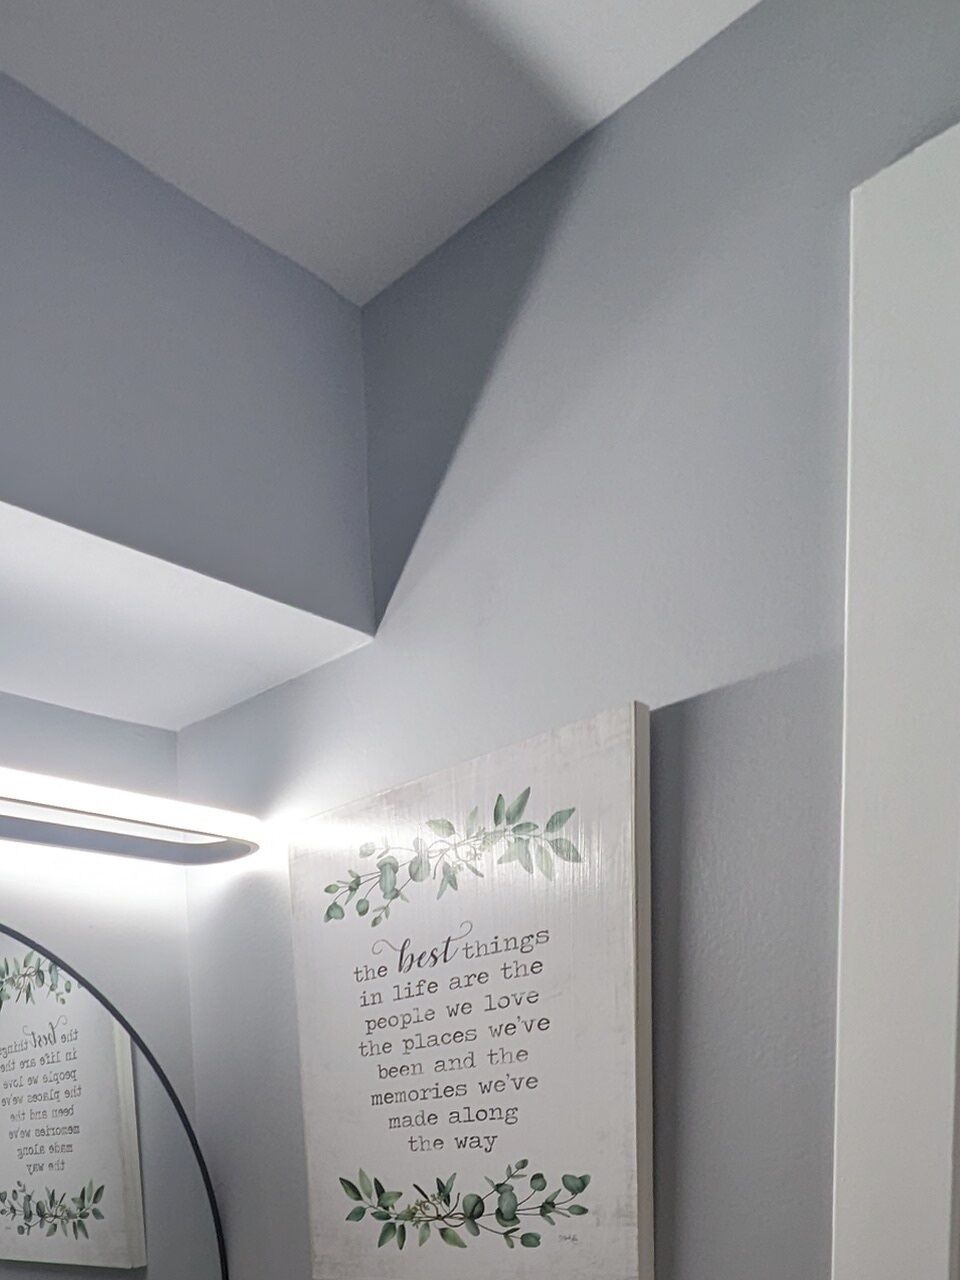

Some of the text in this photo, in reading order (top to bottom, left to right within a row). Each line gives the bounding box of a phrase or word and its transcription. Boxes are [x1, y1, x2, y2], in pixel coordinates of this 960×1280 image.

[354, 965, 388, 983] the
[464, 929, 550, 959] things
[360, 960, 544, 1007] in life are the
[365, 990, 539, 1035] people we love
[358, 1016, 550, 1057] the places we've
[378, 1048, 528, 1079] been and the
[371, 1074, 539, 1106] memories we've
[388, 1107, 518, 1129] made along
[408, 1134, 498, 1153] the way
